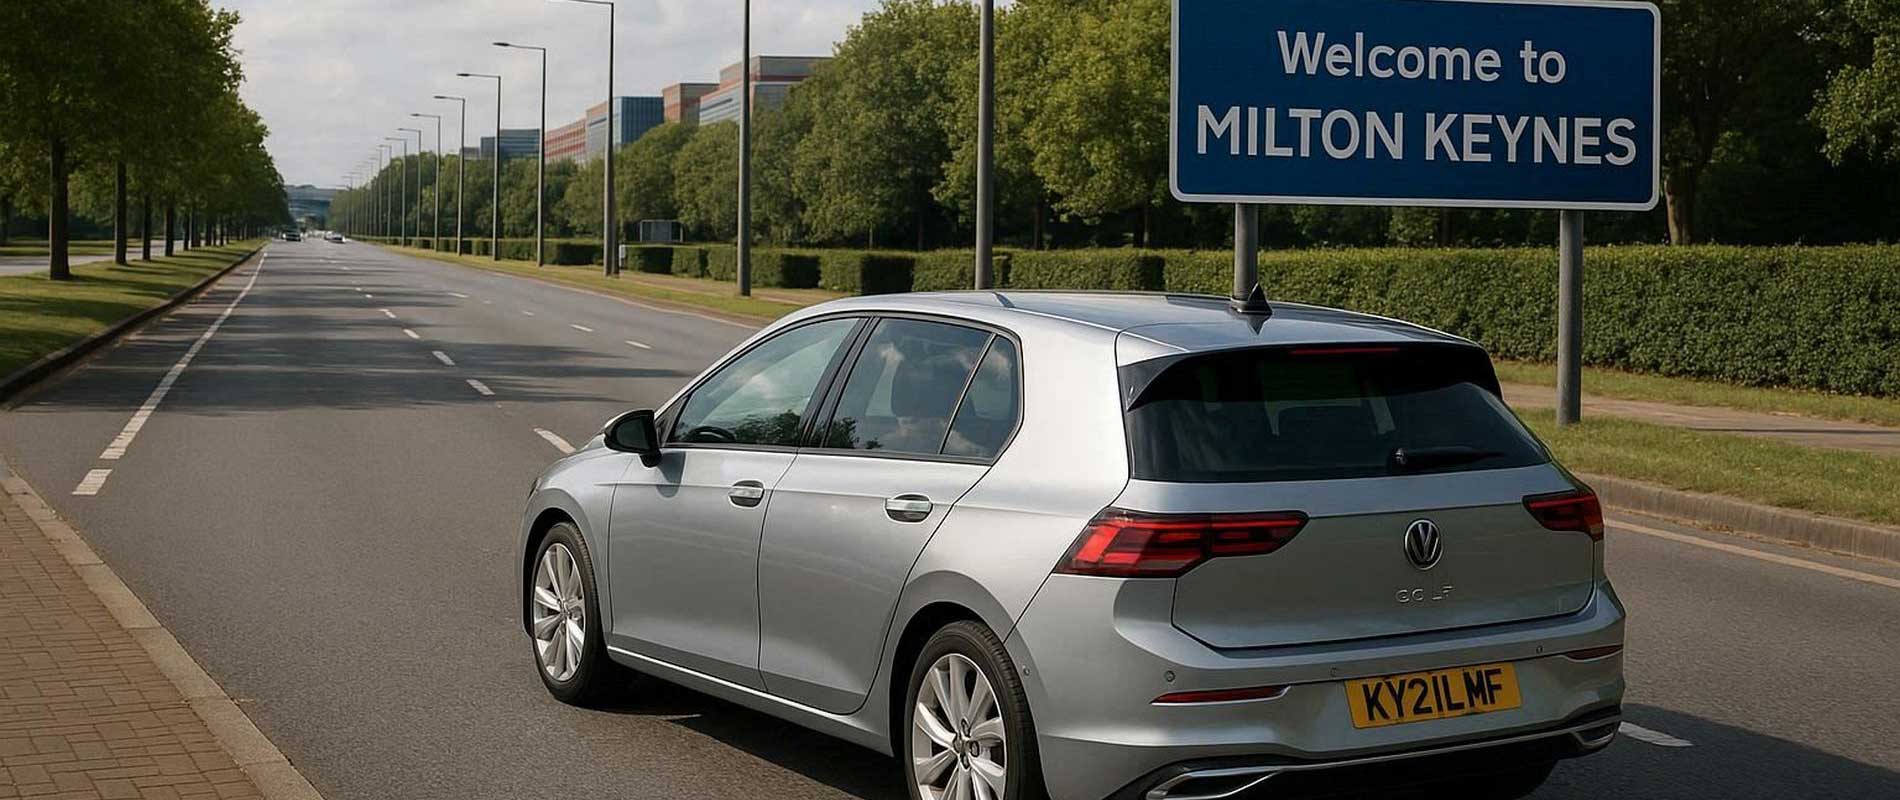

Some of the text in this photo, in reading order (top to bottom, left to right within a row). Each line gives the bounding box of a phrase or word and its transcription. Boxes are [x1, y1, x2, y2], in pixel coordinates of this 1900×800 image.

[1277, 30, 1566, 84] Welcome to
[1197, 105, 1637, 166] MILTON KEYNES
